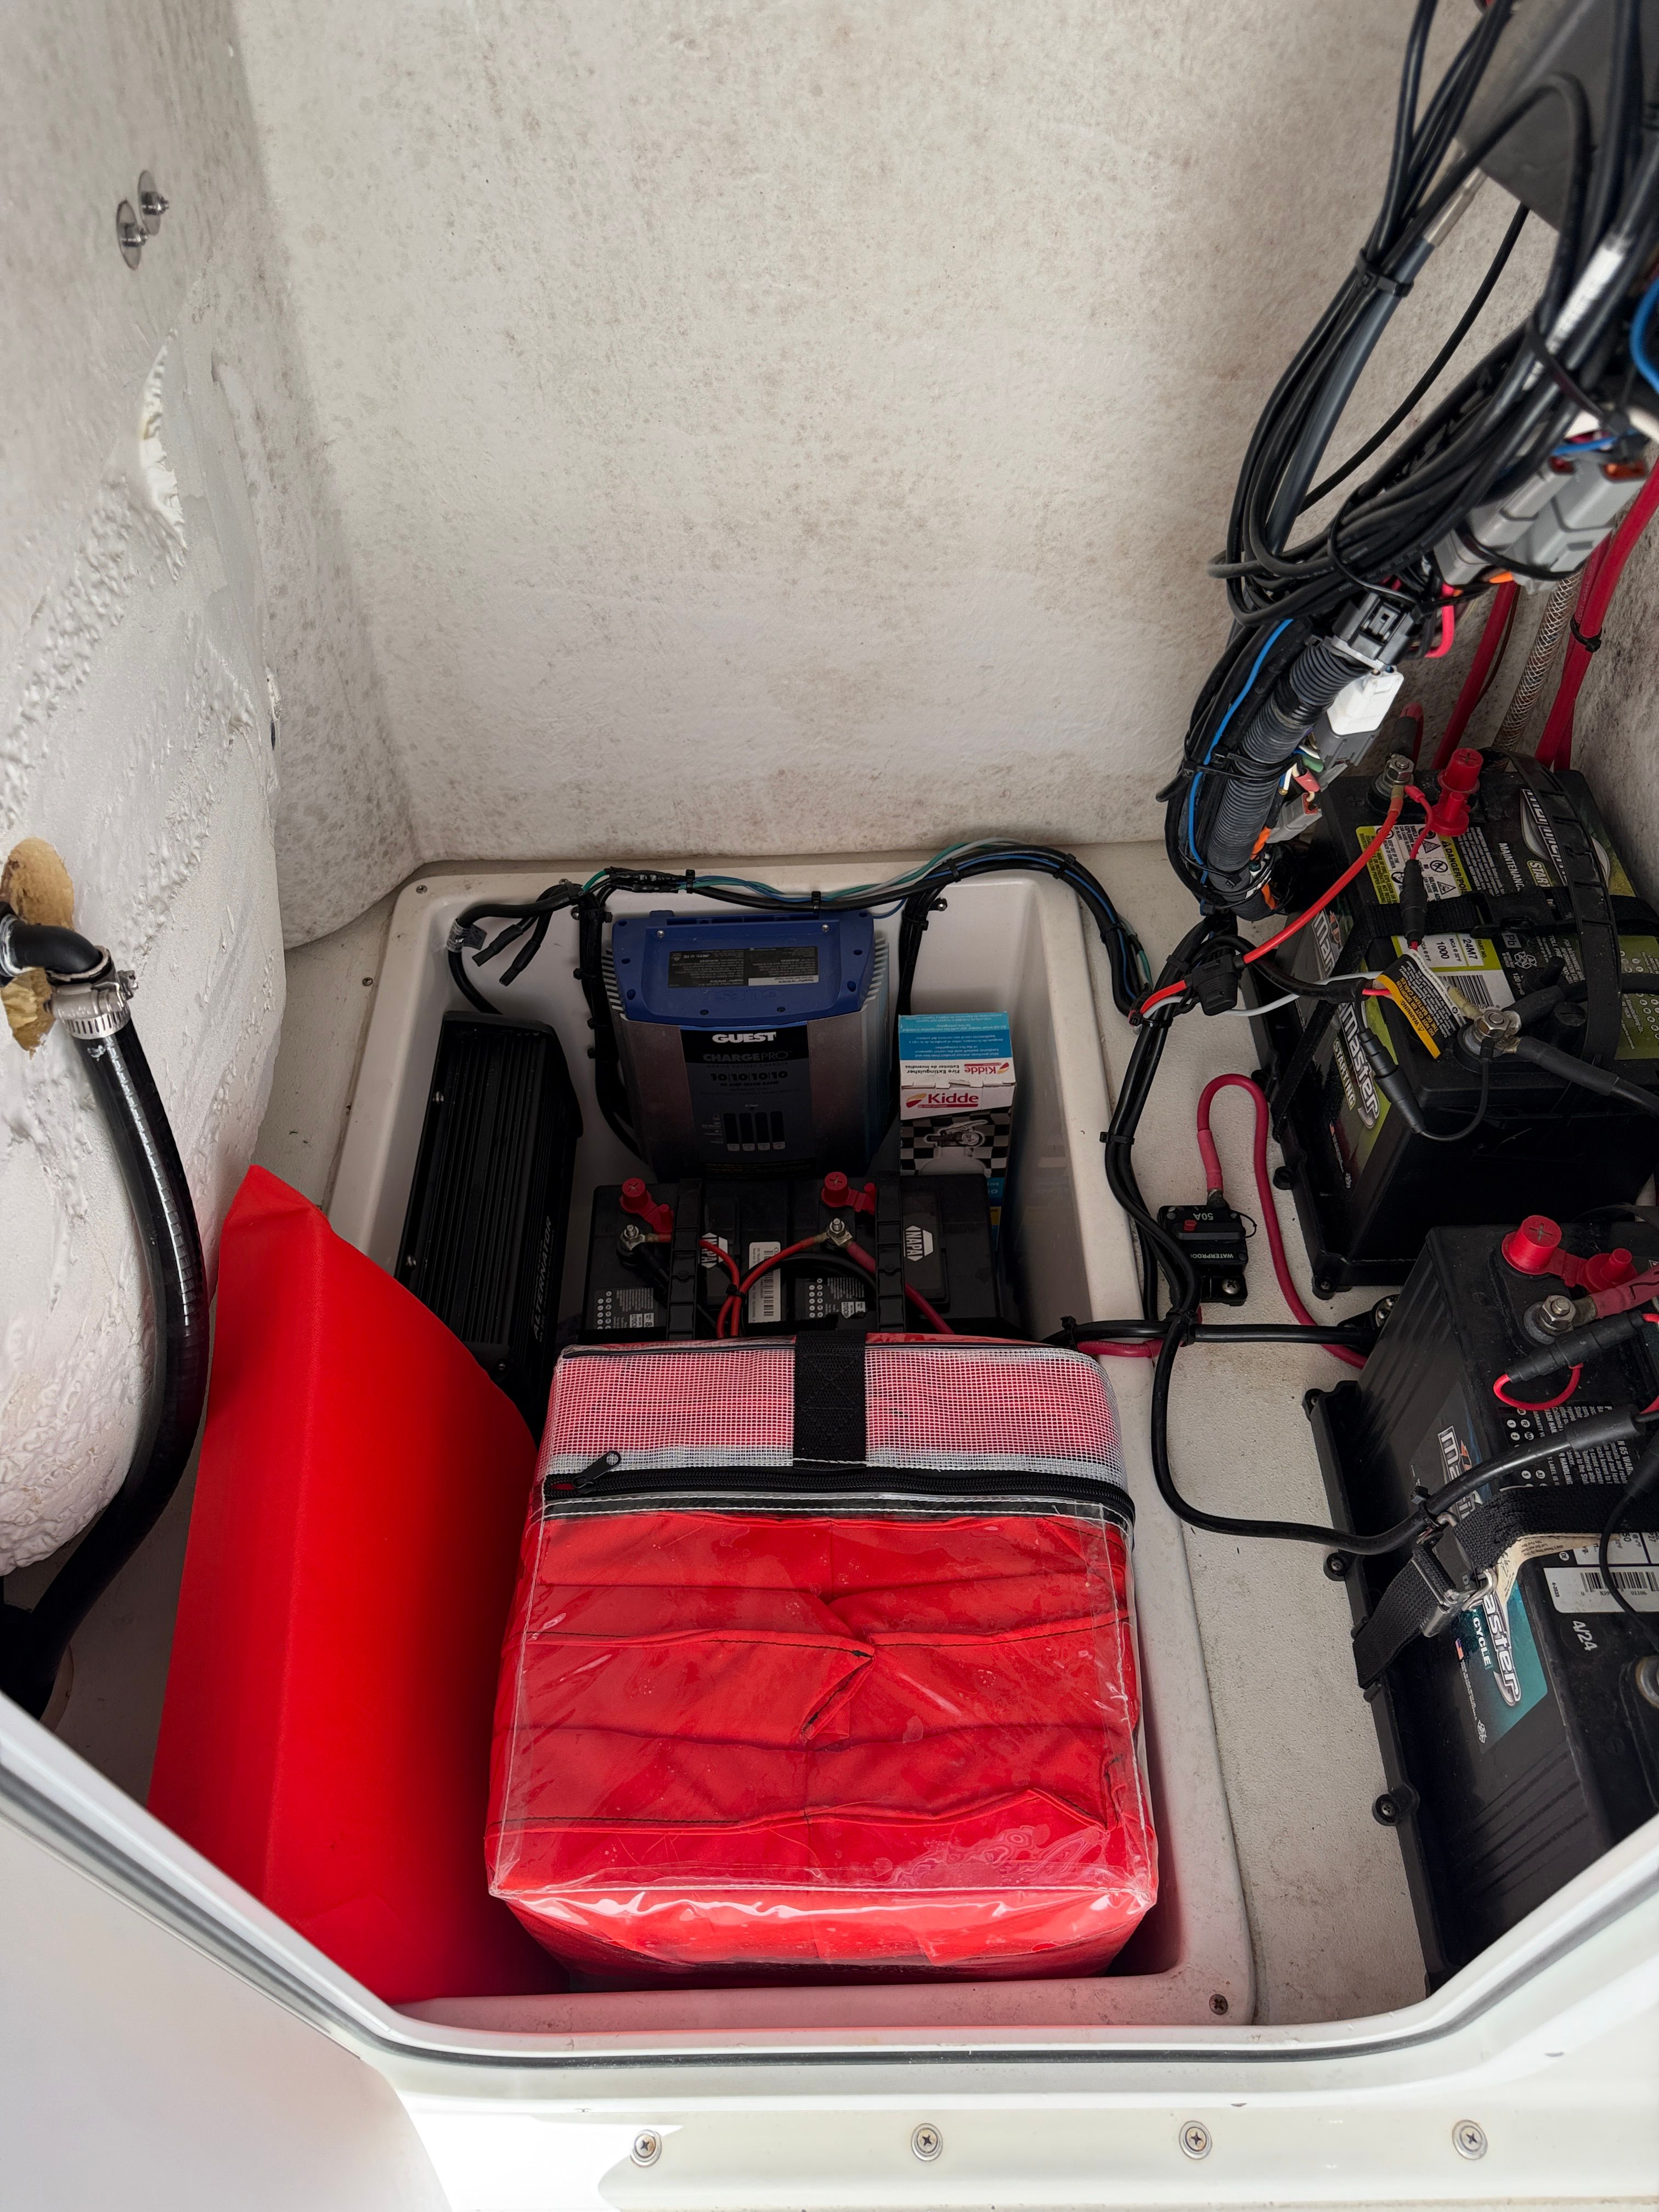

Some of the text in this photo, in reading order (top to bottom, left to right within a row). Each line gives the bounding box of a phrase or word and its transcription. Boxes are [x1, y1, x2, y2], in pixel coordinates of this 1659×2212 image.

[1448, 938, 1457, 949] MCA
[1476, 939, 1484, 951] PART
[1504, 932, 1517, 947] Pb
[1436, 940, 1449, 960] 1000
[1462, 936, 1477, 962] 24M7
[1395, 980, 1436, 1036] DO NOT CUT OR SHORTEN
[1398, 976, 1440, 1032] THE DC BATTERY CABLES
[1398, 998, 1420, 1026] WARNING:
[712, 1031, 777, 1043] GUEST
[964, 1066, 996, 1075] Kidde
[1332, 1039, 1357, 1109] STARTING
[928, 1093, 979, 1104] Kidde
[1192, 1212, 1214, 1220] 50A
[905, 1232, 923, 1256] NAPA
[532, 1215, 553, 1341] ALTERNATOR
[1532, 1410, 1543, 1431] ARRANTY
[1547, 1459, 1557, 1476] LABEL
[1618, 1445, 1628, 1456] 65
[1589, 1451, 1599, 1468] cause
[1604, 1449, 1614, 1463] lead
[1559, 1456, 1573, 1486] HANDLING
[1577, 1464, 1586, 1474] the
[1599, 1457, 1610, 1475] known
[1607, 1460, 1616, 1473] and
[1615, 1460, 1624, 1471] and
[1472, 1616, 1492, 1667] CYCLE
[1572, 1620, 1598, 1651] 4/24
[1481, 1593, 1520, 1697] aster
